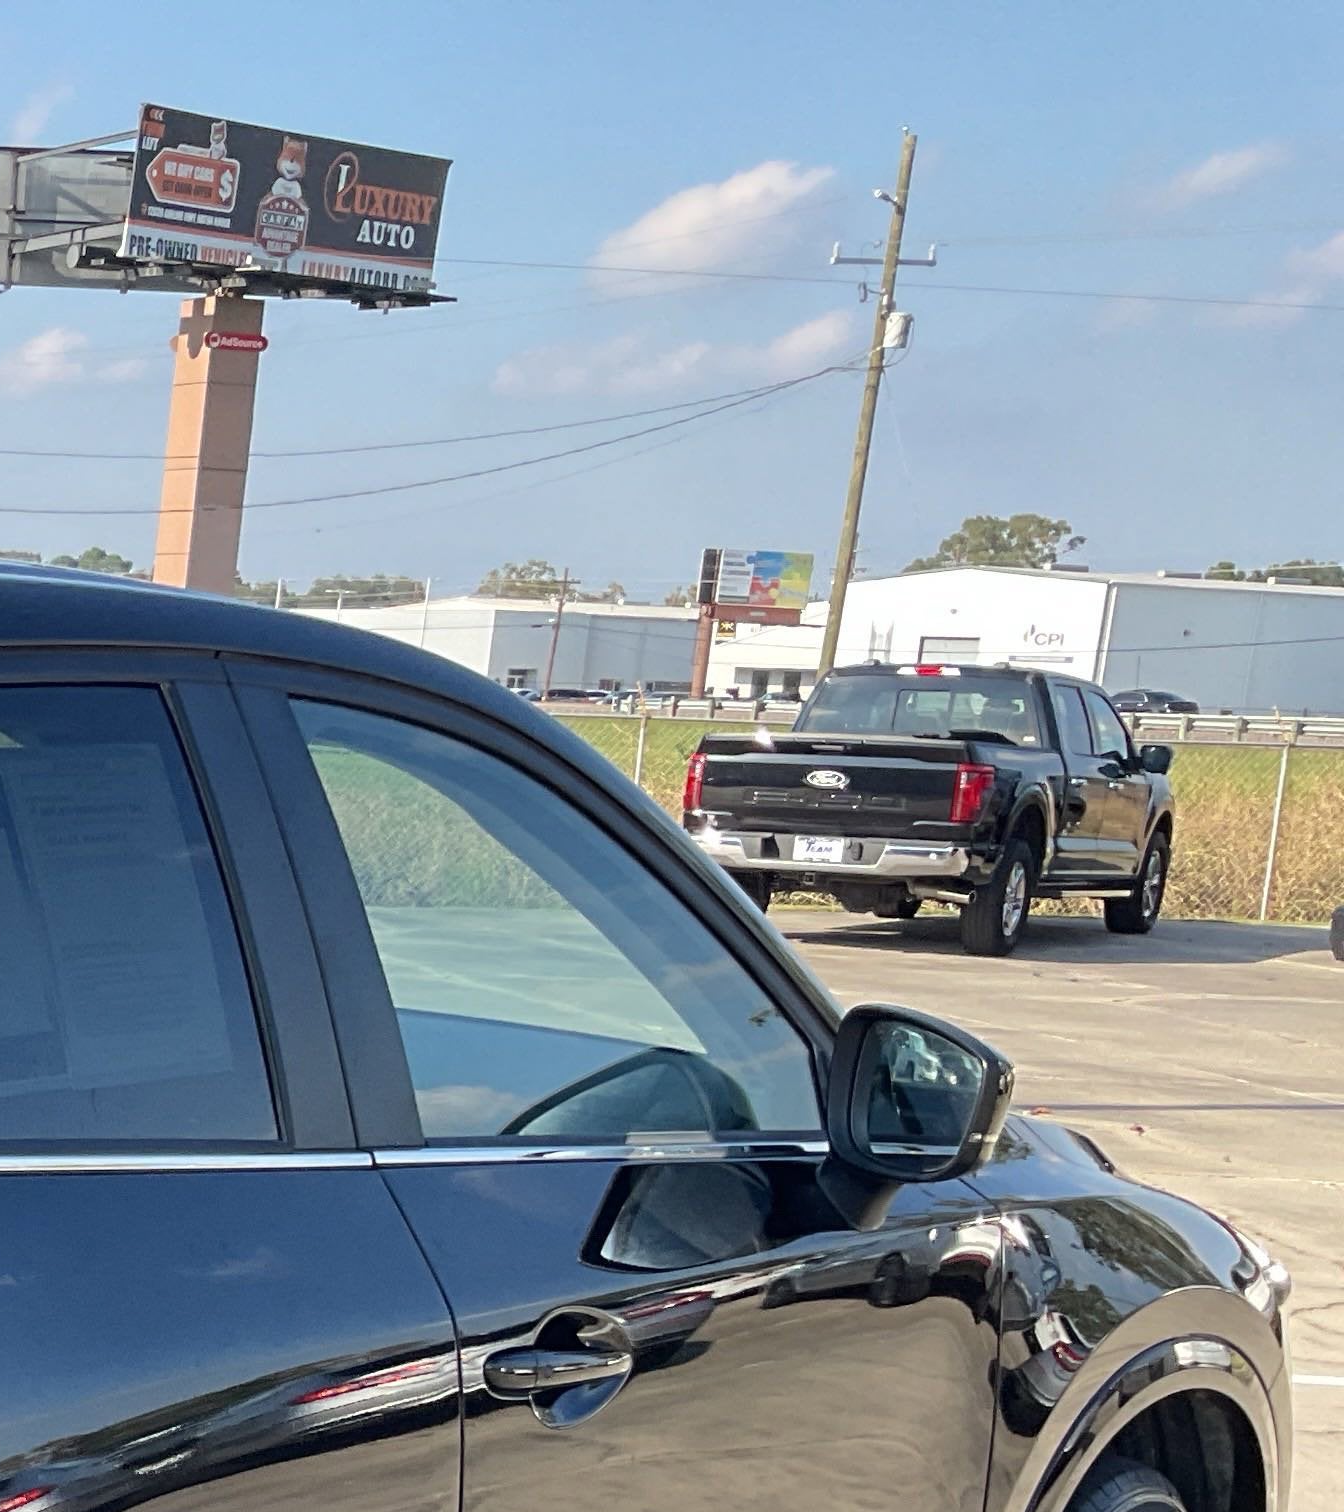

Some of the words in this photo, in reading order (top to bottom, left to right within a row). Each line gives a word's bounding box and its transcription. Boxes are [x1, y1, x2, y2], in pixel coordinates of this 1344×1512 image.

[333, 164, 439, 225] LUXURY
[261, 211, 306, 231] CARFAX
[356, 218, 416, 250] AUTO
[128, 233, 199, 261] PRE-OWNED
[200, 245, 252, 268] VEHICLE
[220, 336, 264, 349] AdSource
[1034, 632, 1065, 647] CPI
